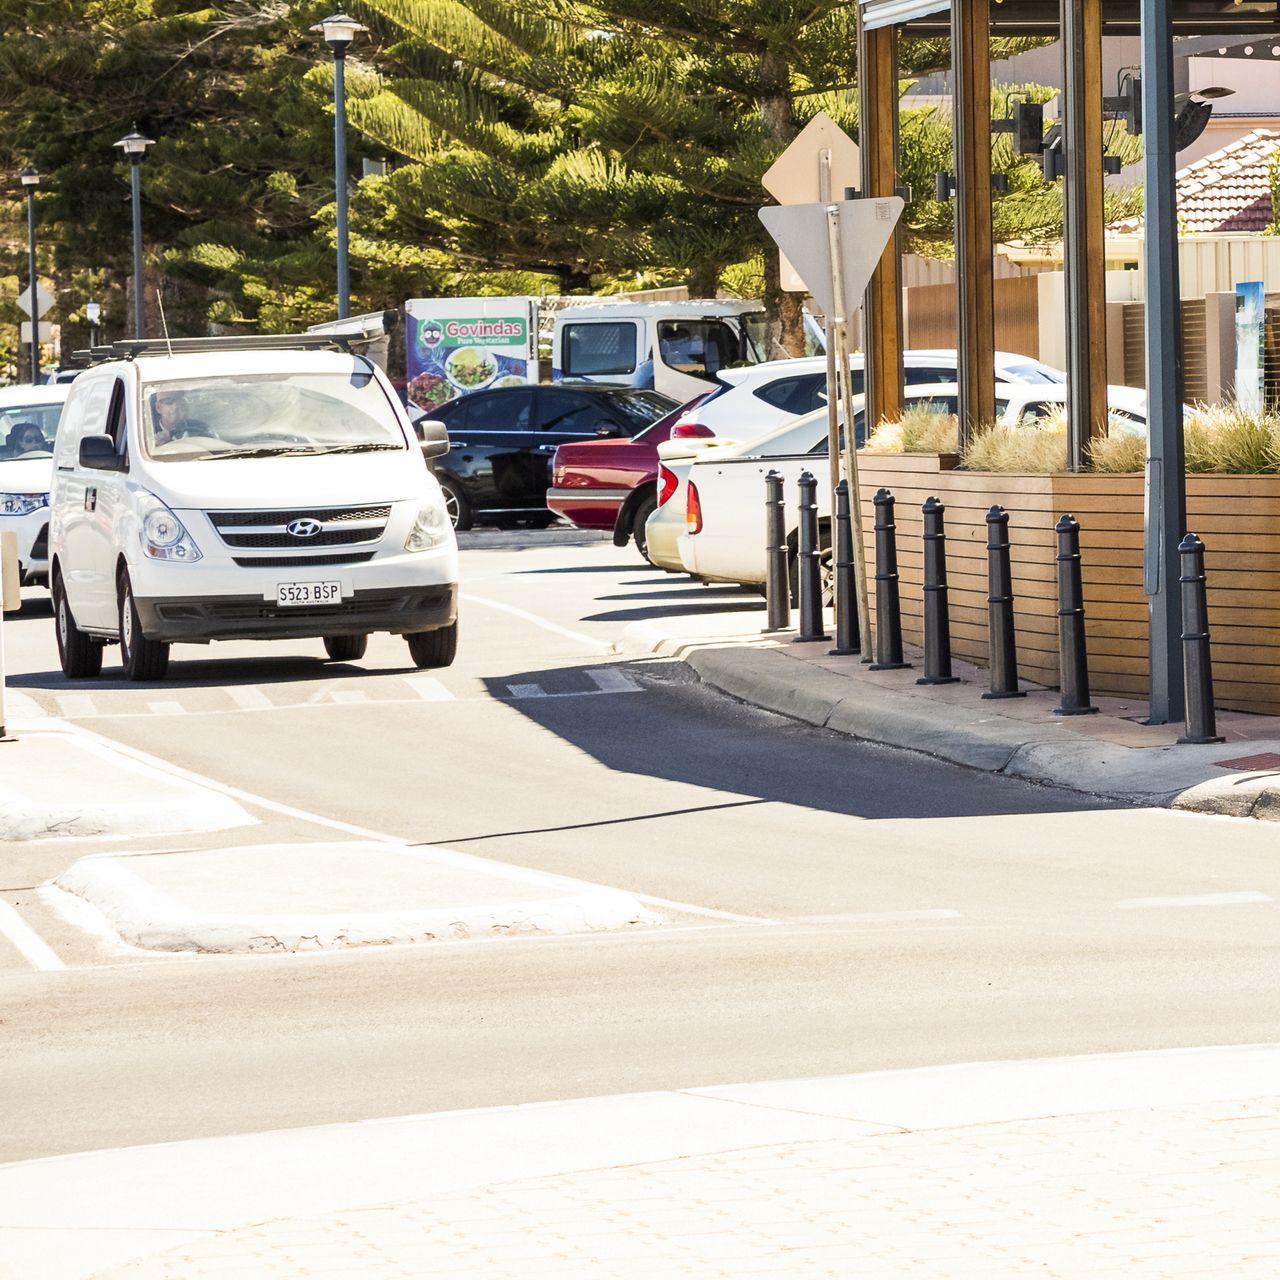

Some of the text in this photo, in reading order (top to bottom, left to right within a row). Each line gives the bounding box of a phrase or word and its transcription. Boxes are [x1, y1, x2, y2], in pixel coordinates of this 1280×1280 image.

[446, 321, 522, 337] Govindas
[280, 585, 338, 601] S523 BSP
